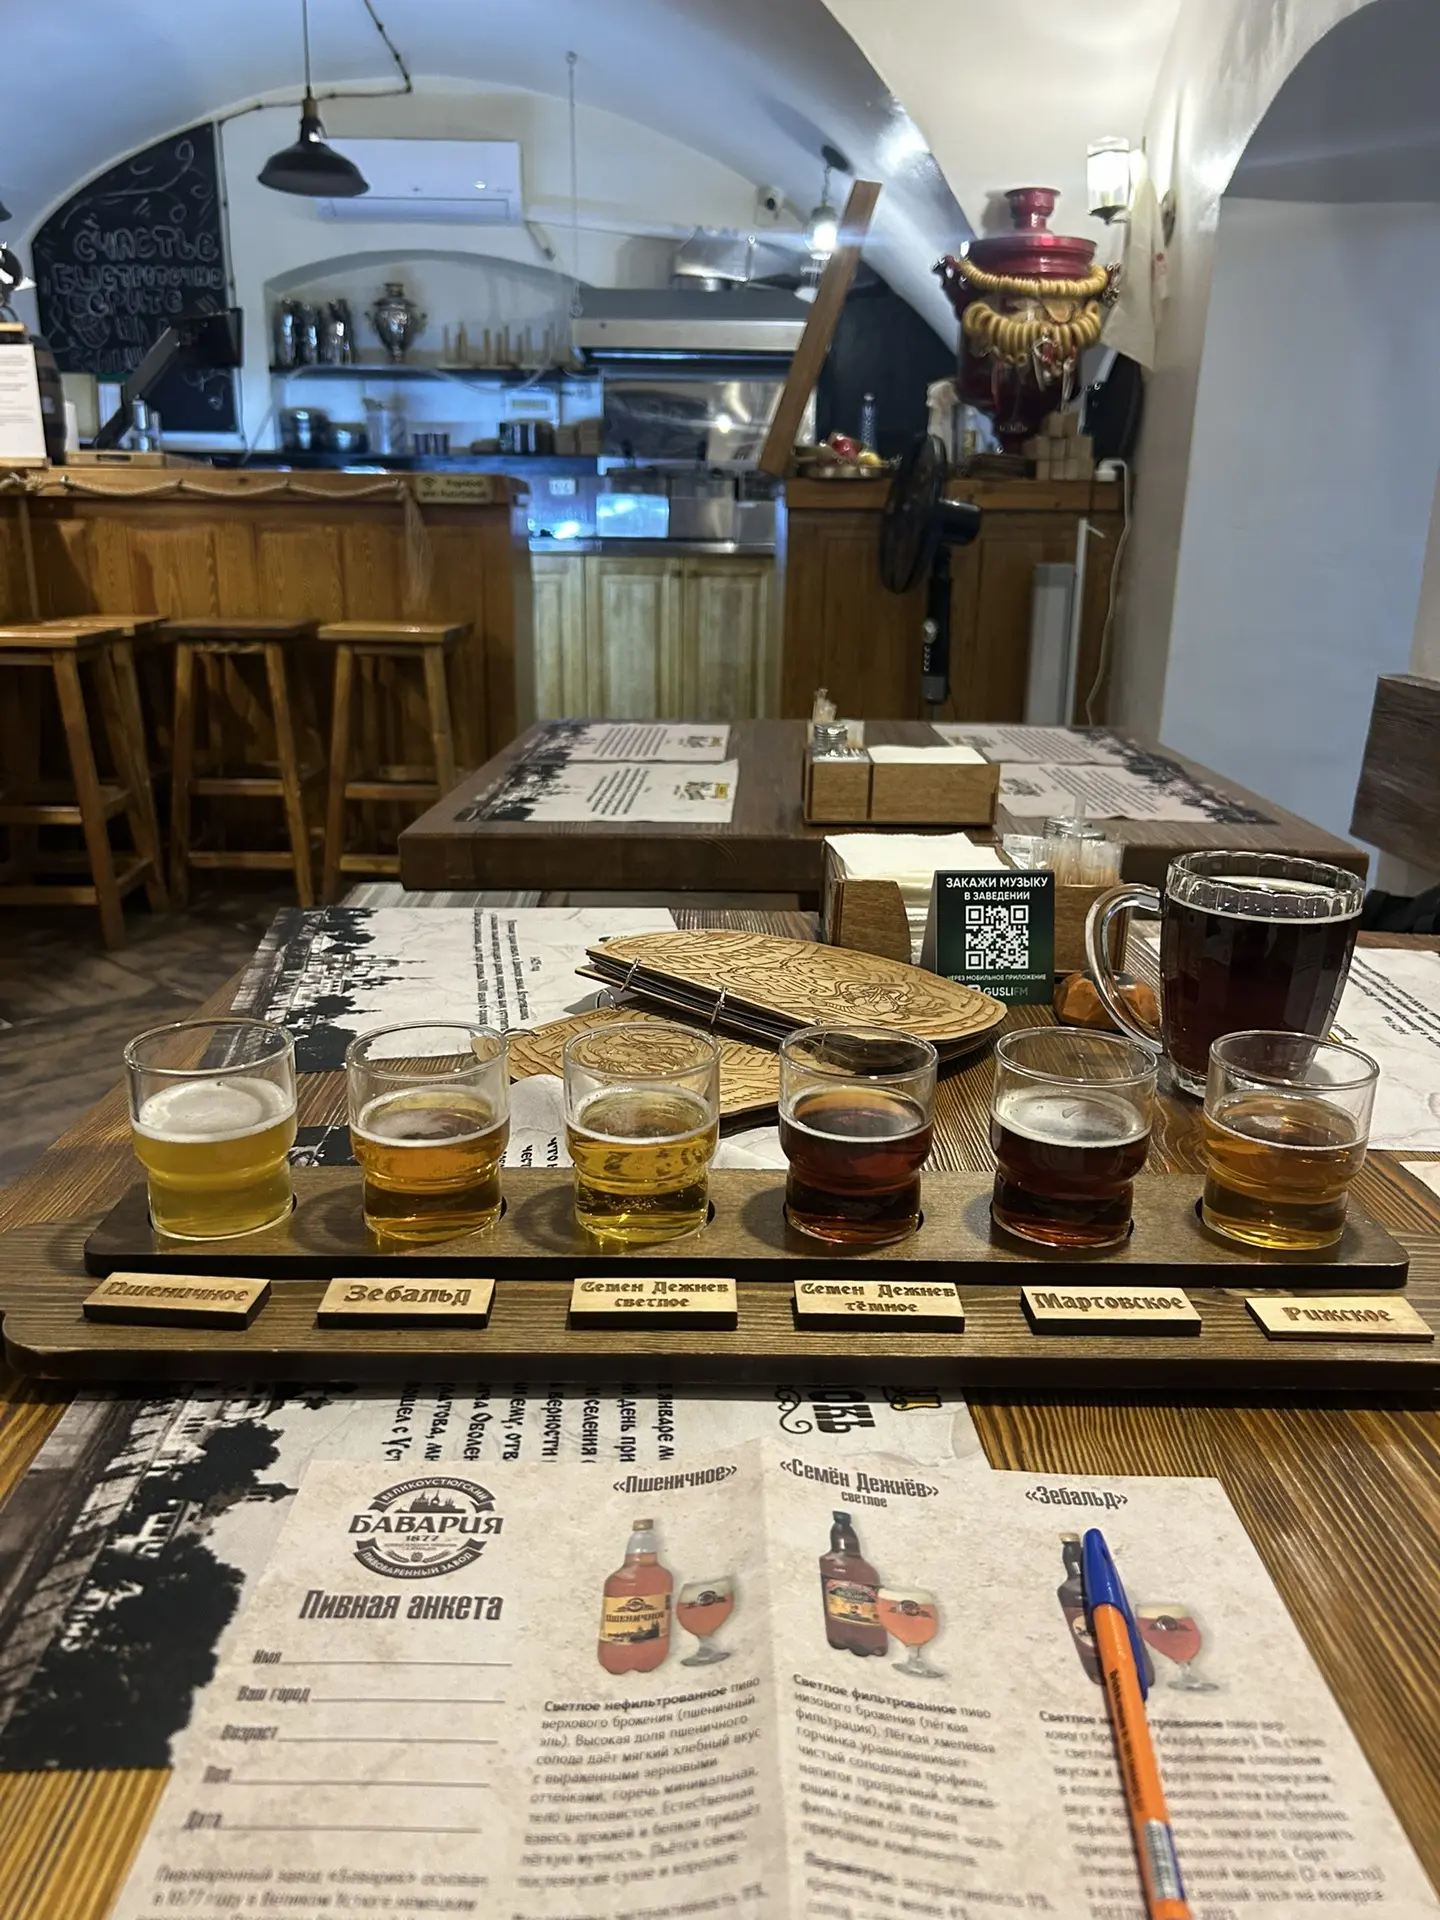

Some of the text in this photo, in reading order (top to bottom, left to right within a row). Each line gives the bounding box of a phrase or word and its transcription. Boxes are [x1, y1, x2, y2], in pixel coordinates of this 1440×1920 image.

[945, 877, 1048, 888] ЗАКАЖИ МУЗЫКУ
[964, 891, 1030, 901] В ЗАВЕДЕНИИ
[102, 1280, 250, 1302] Пшеничное
[343, 1283, 472, 1307] Зебальд
[580, 1280, 729, 1295] Семен Дежнев
[800, 1282, 957, 1298] Семен Дежнев
[613, 1296, 690, 1308] светлое
[844, 1299, 919, 1313] тёмное
[1031, 1291, 1188, 1315] Мартовское
[1281, 1305, 1396, 1323] Рижское
[425, 1383, 455, 1439] латова,
[501, 1398, 527, 1429] ему,
[541, 1392, 564, 1456] верности
[616, 1398, 637, 1432] день
[581, 1398, 600, 1456] селения
[502, 1433, 522, 1461] отв
[380, 1478, 489, 1501] ВЕЛИКОУСТЮГСКИЙ
[612, 1464, 738, 1493] «Пшеничное»
[780, 1458, 939, 1498] «Семён Дежнёв»
[841, 1491, 888, 1508] светлое
[1025, 1485, 1129, 1510] «Зебальд»
[348, 1514, 504, 1534] БАВАРИЯ
[362, 1551, 473, 1576] ПИВОВАРЕННЫЙ ЗАВОД
[299, 1589, 504, 1621] Пивная анкета
[252, 1649, 283, 1664] Имя
[237, 1685, 311, 1704] Ваш город
[544, 1676, 761, 1713] Светлое нефильтрованное пиво
[792, 1672, 991, 1720] Светлое фильтрованное пиво
[541, 1693, 756, 1732] верхового брожения (пшеничный
[794, 1691, 969, 1734] низового брожения (лёгкая
[1039, 1710, 1096, 1724] Светлое
[220, 1724, 279, 1744] Возраст
[575, 1733, 630, 1747] Высокая
[634, 1731, 665, 1744] доля
[669, 1714, 748, 1738] пшеничного
[795, 1706, 996, 1754] фильтрация). Лёгкая хмелевая
[536, 1728, 761, 1766] солода даёт мягкий хлебный вкус
[796, 1725, 968, 1769] горчинка уравновешивает
[544, 1769, 639, 1787] выраженными
[643, 1757, 718, 1779] зерновыми
[798, 1744, 846, 1763] чистый
[849, 1754, 922, 1780] солодовый
[613, 1788, 660, 1803] горечь
[664, 1766, 759, 1795] минимальная,
[662, 1786, 755, 1815] Естественная
